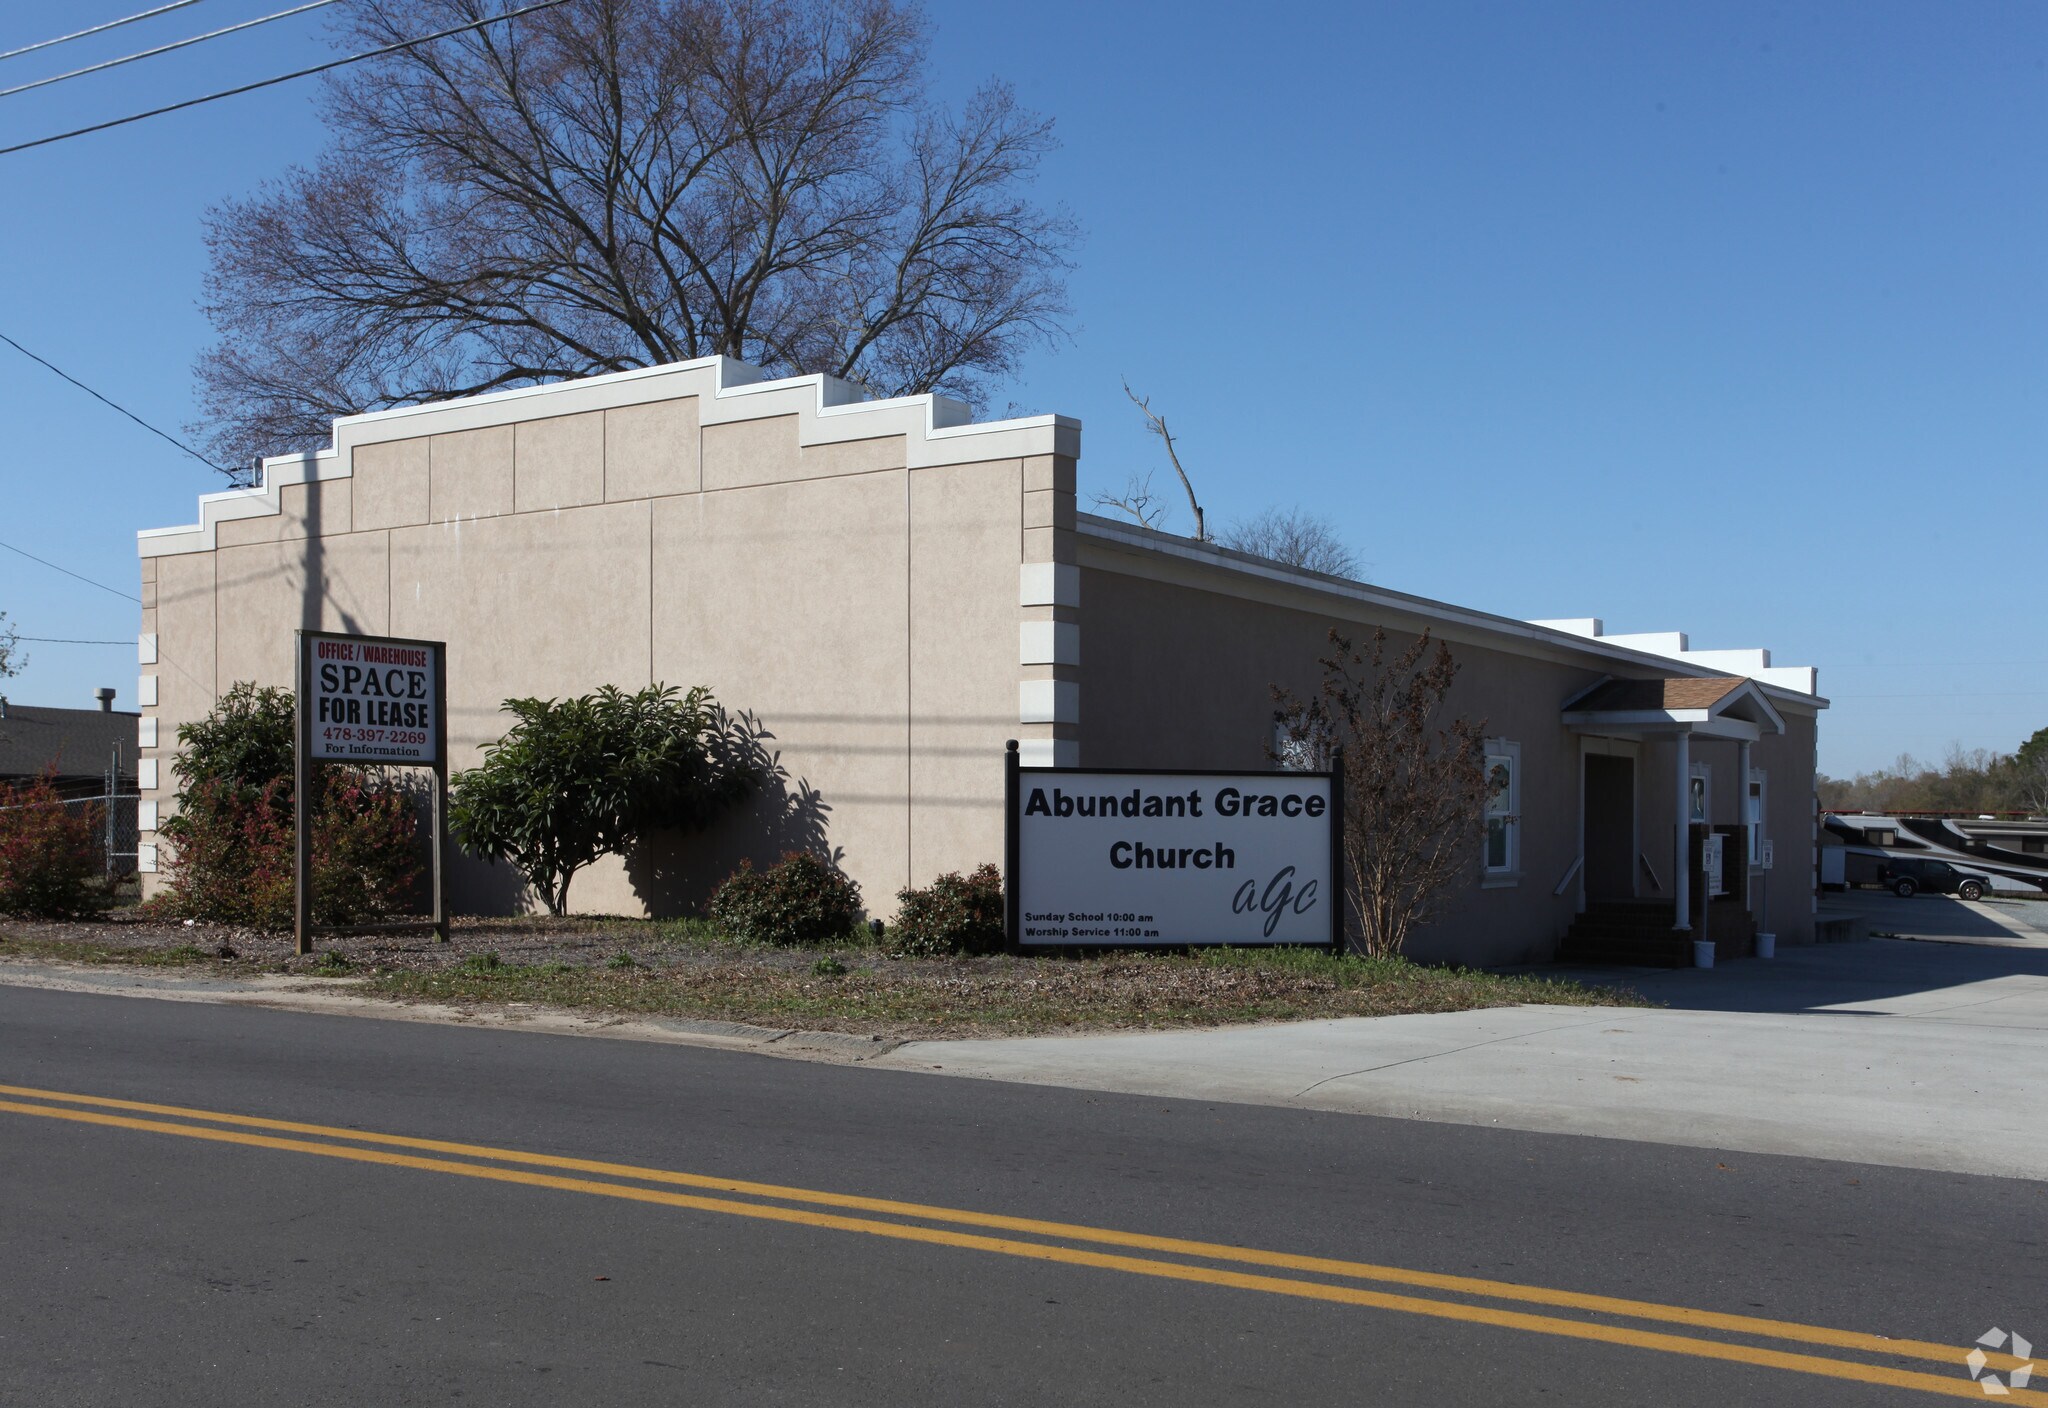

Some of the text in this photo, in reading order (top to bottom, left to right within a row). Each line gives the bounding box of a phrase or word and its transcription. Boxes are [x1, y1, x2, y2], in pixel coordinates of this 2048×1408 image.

[318, 641, 354, 661] OFFICE
[363, 645, 427, 668] WAREHOUSE
[320, 663, 427, 699] SPACE
[319, 697, 428, 728] FOR LEASE
[323, 727, 426, 744] 478-397-2269
[325, 743, 420, 756] For Information
[1025, 787, 1326, 817] Abundant Grace
[1109, 841, 1235, 869] Church
[1025, 912, 1153, 923] Sunday School 10:00 am
[1025, 927, 1069, 938] Worship
[1072, 927, 1110, 936] Service
[1113, 928, 1141, 937] 11:00
